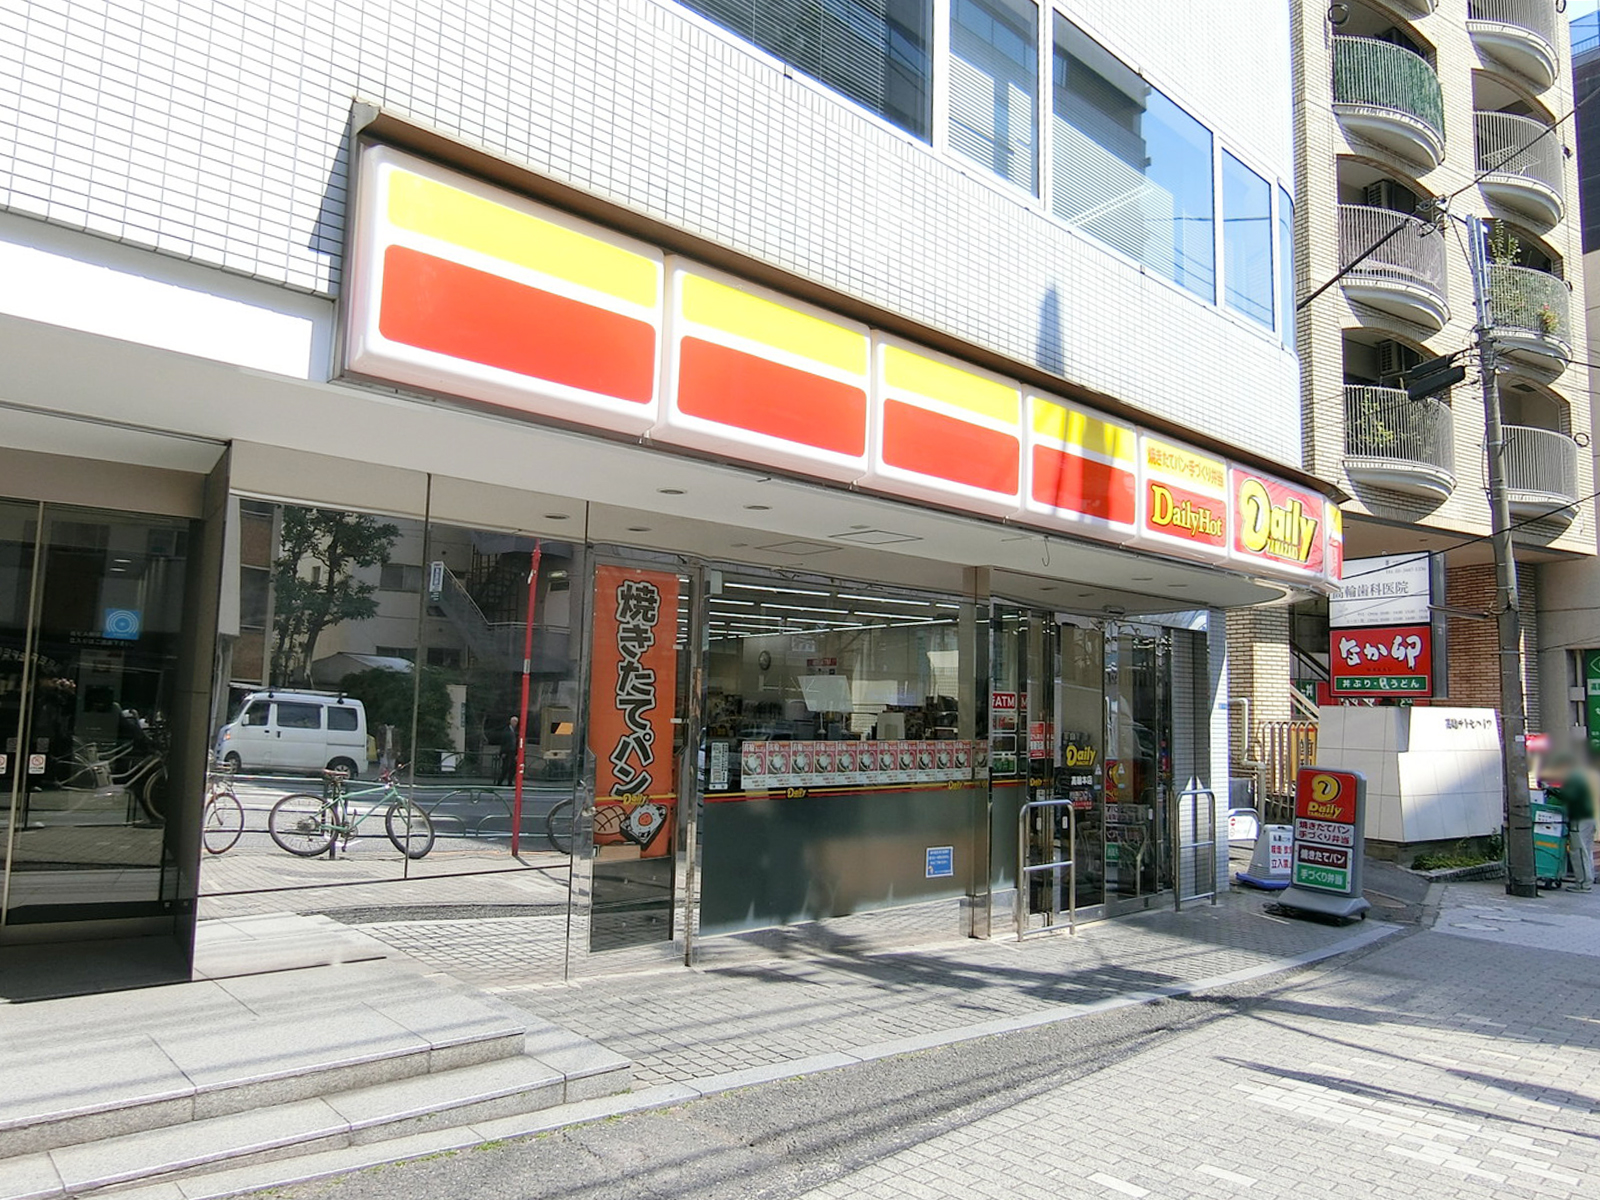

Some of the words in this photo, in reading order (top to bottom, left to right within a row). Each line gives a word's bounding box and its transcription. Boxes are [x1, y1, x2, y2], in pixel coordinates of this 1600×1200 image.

[1240, 477, 1318, 563] Daily
[1338, 635, 1422, 671] なか卯
[609, 579, 661, 798] 焼きたてパン
[1066, 745, 1097, 767] Daily
[786, 787, 807, 799] Daily
[1308, 801, 1344, 819] Daily
[1299, 821, 1350, 834] 焼きたてパン
[1299, 831, 1350, 845] 手づくり弁当
[1300, 849, 1346, 864] 焼きたてパン
[1301, 868, 1344, 885] 手づくり弁当
